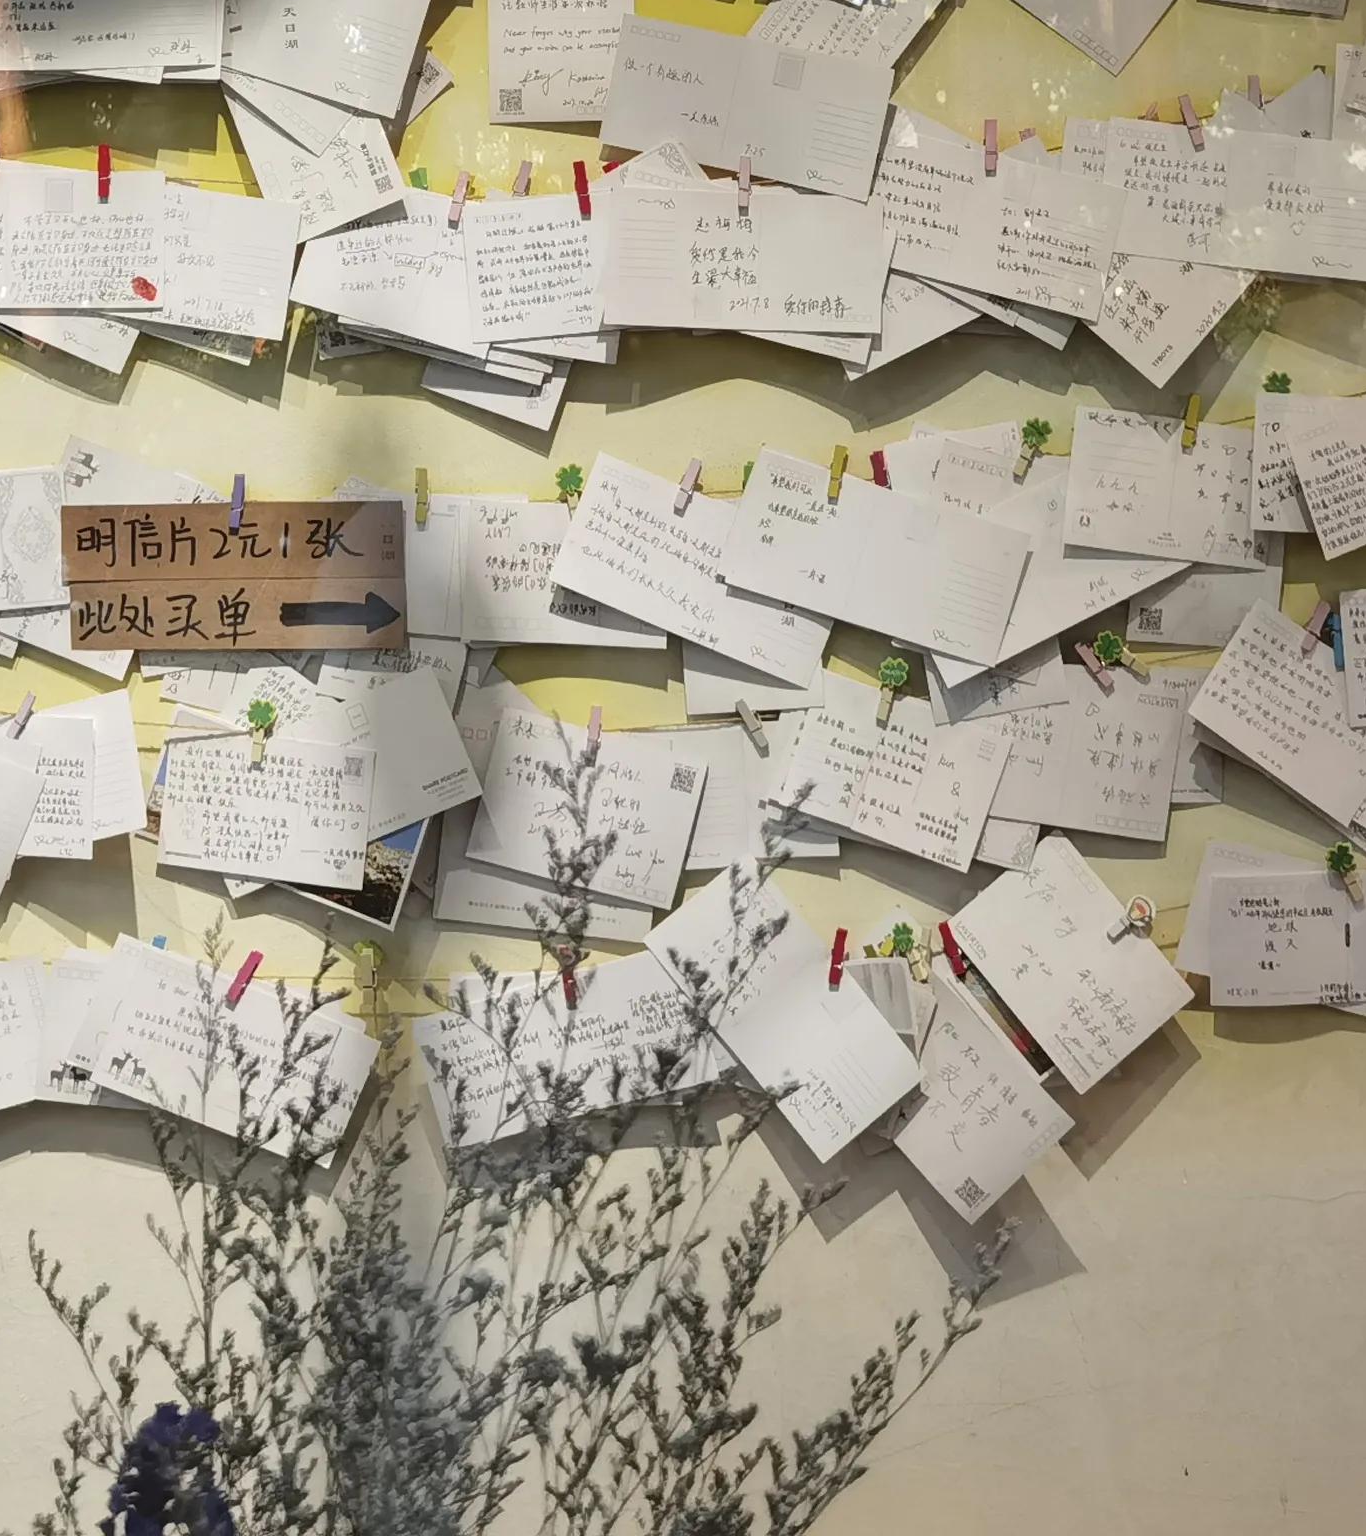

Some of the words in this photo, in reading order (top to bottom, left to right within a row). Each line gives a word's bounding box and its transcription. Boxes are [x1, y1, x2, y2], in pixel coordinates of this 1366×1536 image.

[76, 513, 364, 568] 明信片2元1张
[78, 587, 256, 646] 此处买单
